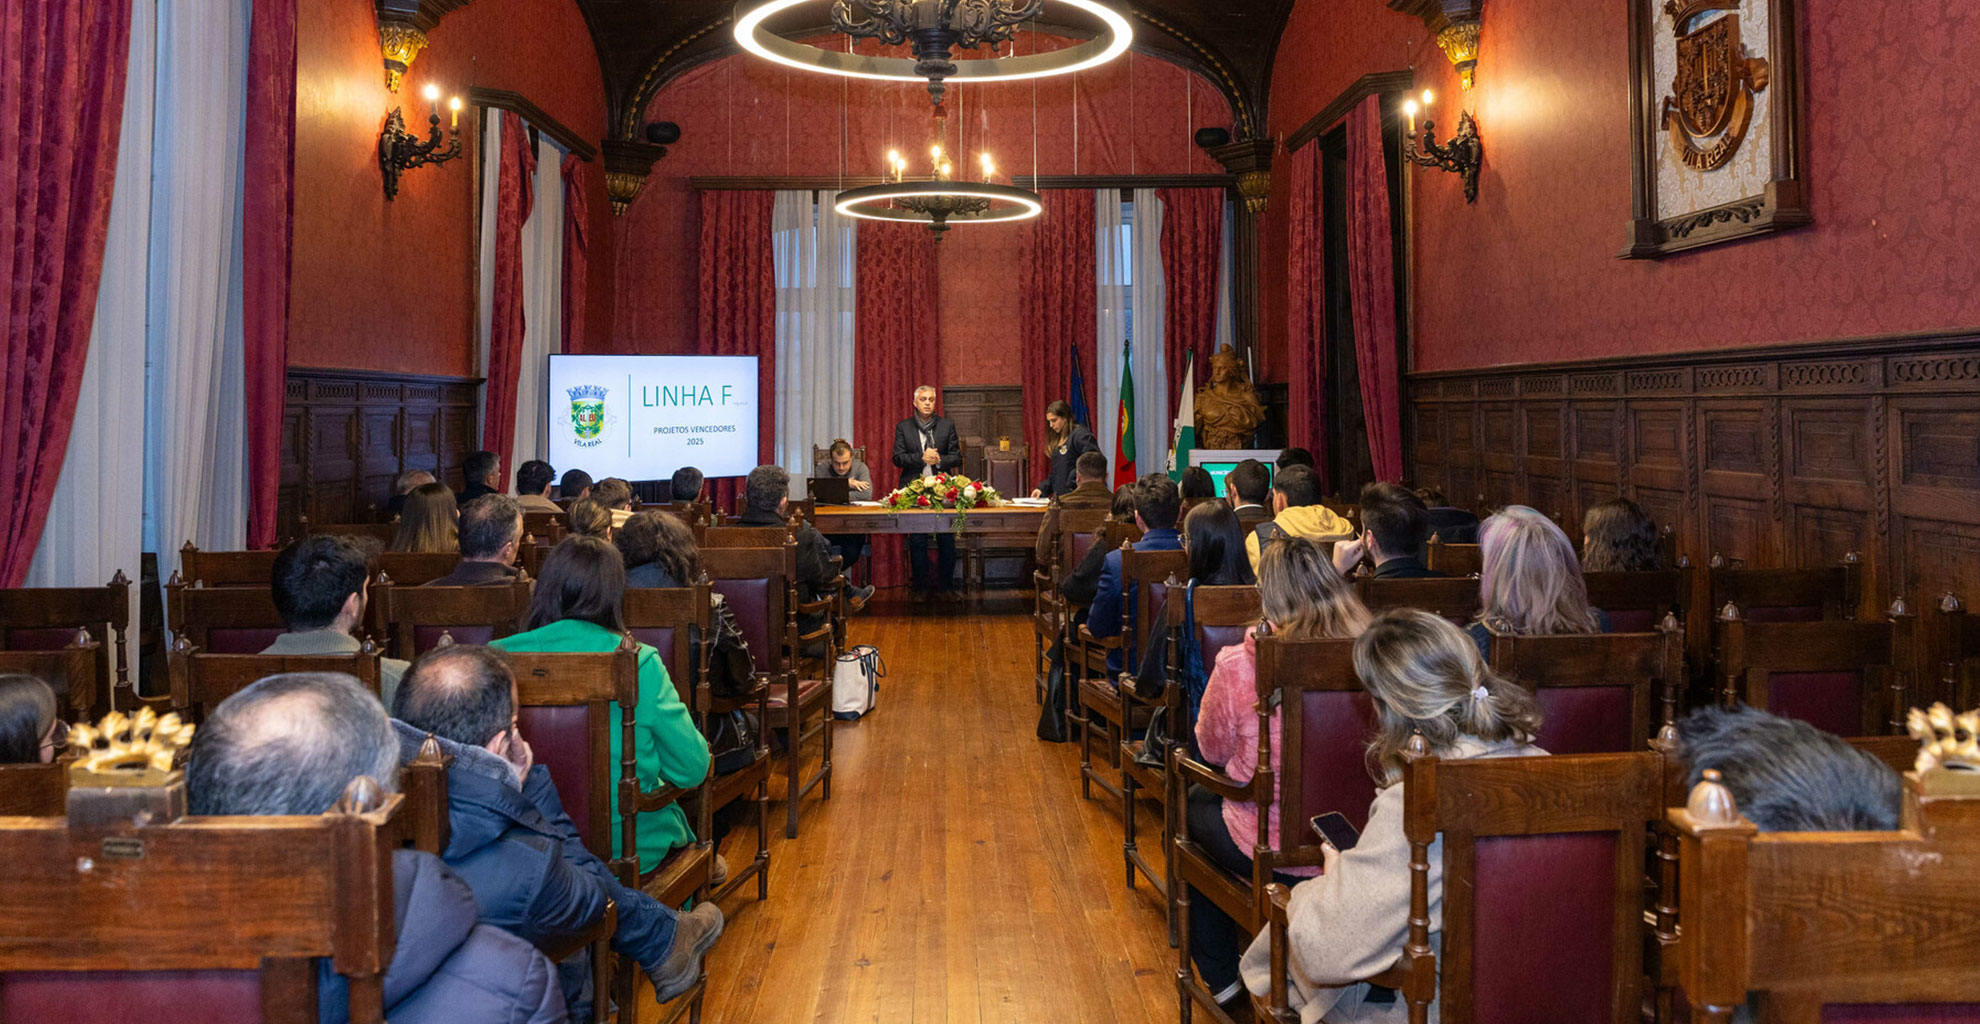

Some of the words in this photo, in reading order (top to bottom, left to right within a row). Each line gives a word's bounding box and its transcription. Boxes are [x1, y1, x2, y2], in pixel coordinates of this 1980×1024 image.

[1682, 147, 1702, 169] VILA
[1706, 134, 1732, 169] REAL
[643, 385, 713, 407] LINHA
[722, 385, 732, 406] F
[653, 426, 689, 434] PROJETOS
[690, 425, 736, 433] VENCEDORES
[574, 438, 587, 447] VILA
[588, 438, 602, 447] REAL
[687, 438, 704, 446] 2025
